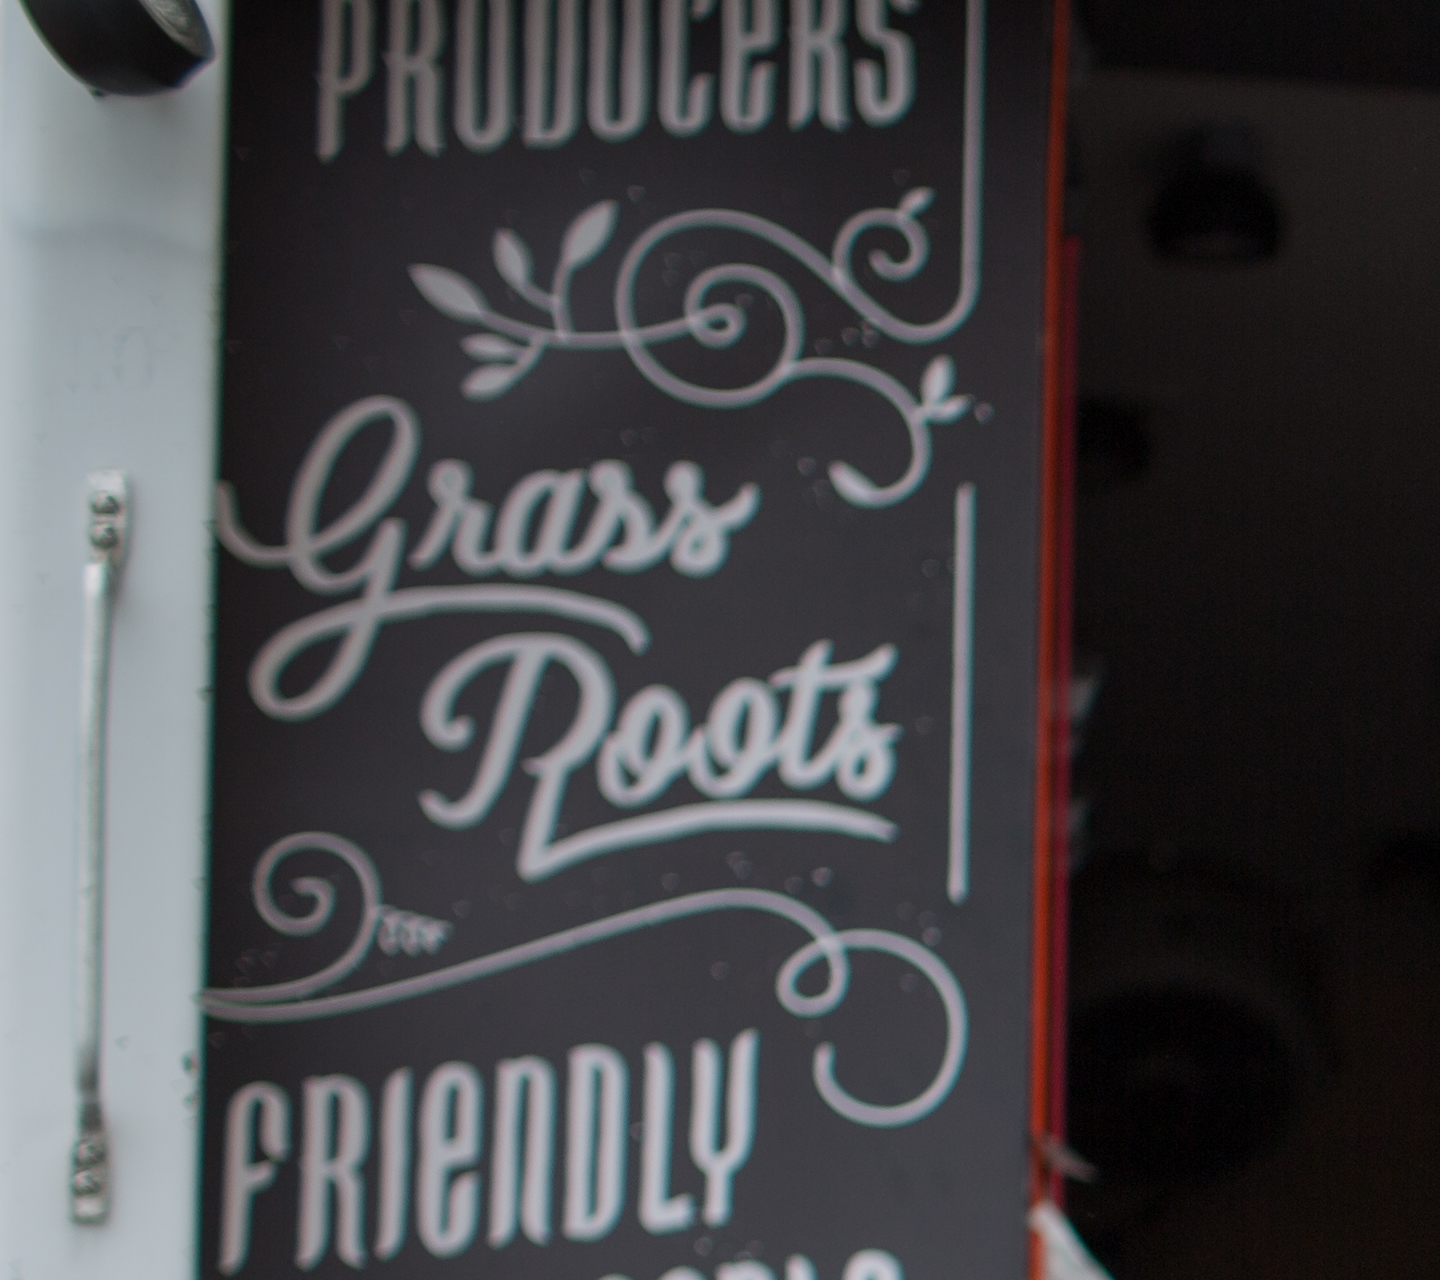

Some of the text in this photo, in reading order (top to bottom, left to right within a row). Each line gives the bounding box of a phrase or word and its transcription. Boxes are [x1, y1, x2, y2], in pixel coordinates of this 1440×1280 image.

[215, 395, 761, 721] Grass
[419, 633, 899, 882] Roots
[218, 1029, 760, 1276] FRIENDLY
